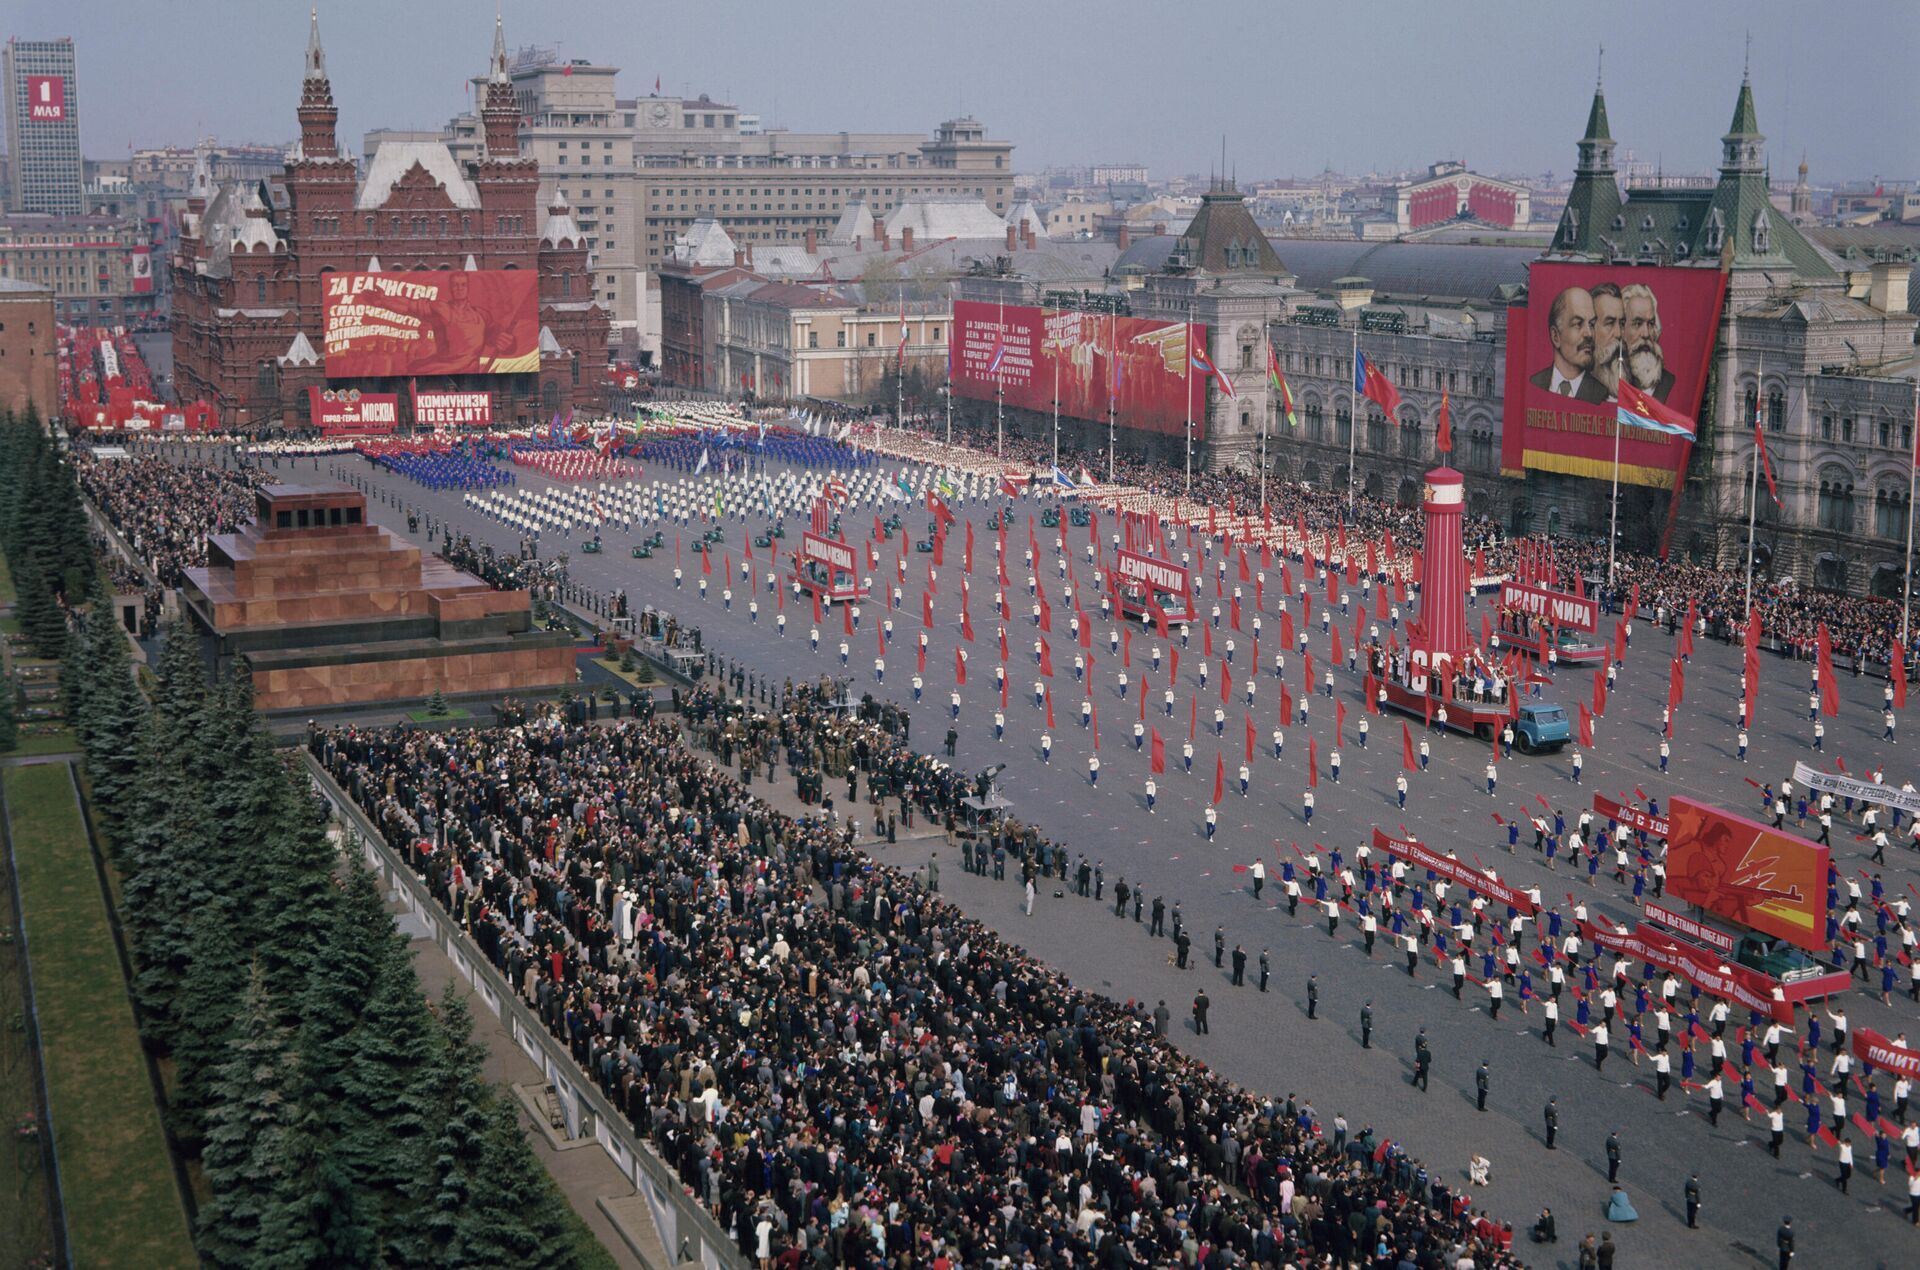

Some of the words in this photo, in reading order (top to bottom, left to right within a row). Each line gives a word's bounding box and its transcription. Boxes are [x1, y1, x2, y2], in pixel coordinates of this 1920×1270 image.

[40, 81, 50, 102] 1
[33, 105, 61, 117] МАЯ
[328, 277, 348, 296] ЗА
[340, 295, 354, 304] И
[329, 316, 363, 330] ВСЕХ
[328, 339, 350, 354] СИЛ
[965, 340, 994, 351] СОЛИДАРНОС
[983, 332, 1031, 346] МЕЖНАРОДНОЙ
[1003, 355, 1034, 368] МПЕРИАЛИЗМА,
[997, 365, 1031, 377] МОКРАТИЮ
[417, 394, 489, 409] КОММУНИЗМ
[322, 413, 360, 423] ГОРОД-ГЕРОЙ
[361, 402, 395, 422] МОСКВА
[417, 407, 489, 422] ПОБЕДИТ!
[1569, 412, 1603, 436] ПОБЕДЕ
[1119, 555, 1183, 592] ДЕМОКРАТИИ
[1551, 598, 1591, 627] МИРА
[1617, 807, 1635, 822] МЫ
[1637, 815, 1645, 826] С
[1649, 819, 1669, 835] ТОБ
[1389, 840, 1409, 854] СЛАВА
[1645, 904, 1666, 923] НАРОД
[1667, 912, 1700, 938] ВЬЕТНАМА
[1700, 925, 1733, 950] ПОБЕДИТ!
[1723, 979, 1734, 992] ЗА
